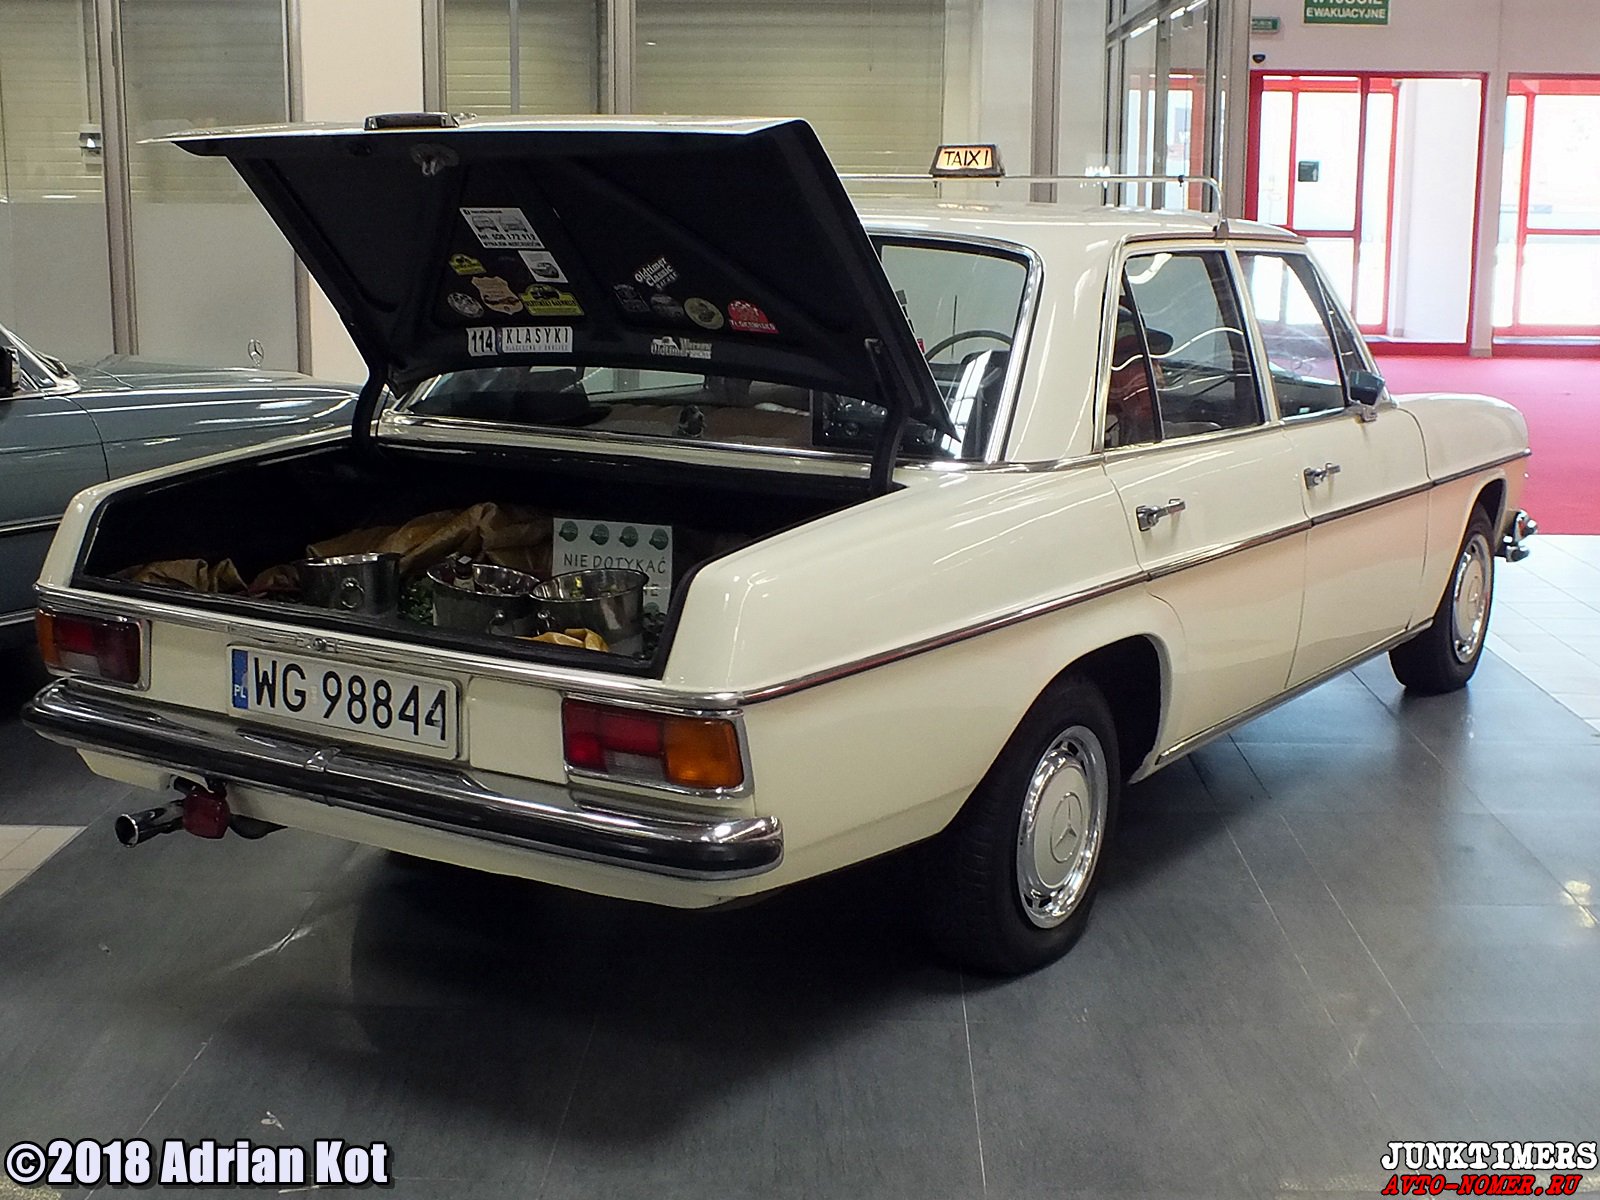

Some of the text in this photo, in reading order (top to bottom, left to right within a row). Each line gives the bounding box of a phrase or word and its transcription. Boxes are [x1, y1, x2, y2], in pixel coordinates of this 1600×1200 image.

[1306, 6, 1386, 19] EWAKUACYJNE
[634, 257, 667, 283] Oldtimer
[645, 265, 674, 287] Classic
[472, 329, 492, 353] 114
[506, 328, 568, 344] KLASYKI
[563, 553, 666, 574] NIE DOTYKAĆ
[234, 685, 247, 698] PL
[253, 656, 446, 741] WG 98844
